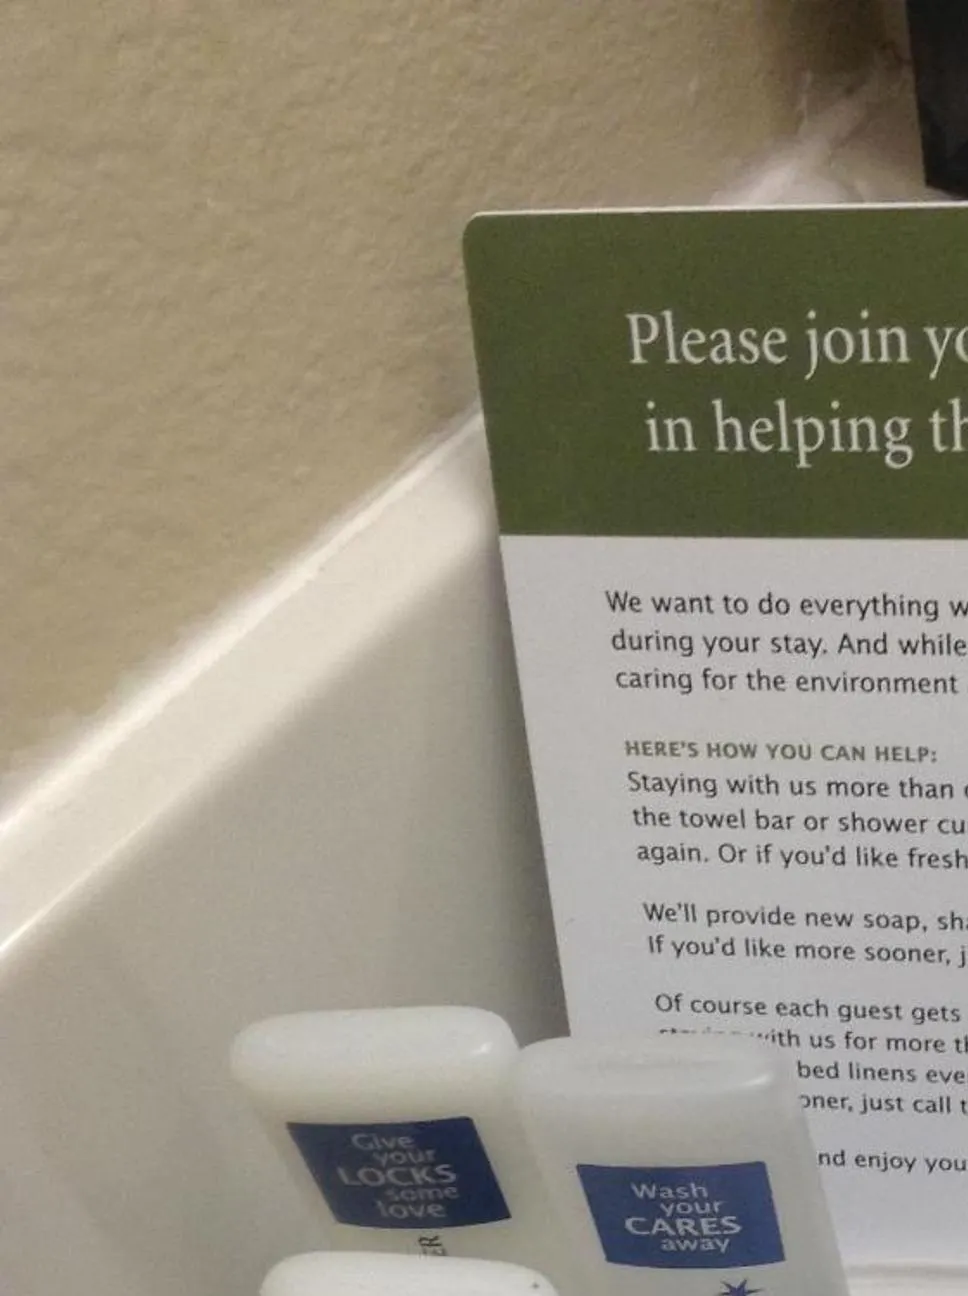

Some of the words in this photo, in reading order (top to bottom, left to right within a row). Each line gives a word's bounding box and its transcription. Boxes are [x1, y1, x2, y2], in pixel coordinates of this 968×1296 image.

[626, 309, 788, 365] Please
[804, 309, 912, 381] join
[645, 400, 698, 453] in
[711, 398, 915, 470] helping
[604, 589, 643, 614] We
[650, 593, 715, 615] want
[721, 594, 750, 616] to
[757, 591, 791, 616] do
[799, 591, 940, 624] everything
[610, 627, 694, 658] during
[701, 635, 761, 659] your
[770, 633, 829, 660] stay.
[836, 631, 889, 656] And
[897, 631, 968, 658] while
[615, 667, 693, 696] caring
[701, 666, 738, 691] for
[745, 667, 787, 693] the
[795, 670, 960, 695] environment
[624, 740, 700, 759] HERE'S
[705, 741, 758, 760] HOW
[765, 743, 812, 761] YOU
[819, 744, 866, 762] CAN
[874, 745, 938, 764] HELP:
[627, 770, 718, 799] Staying
[725, 773, 780, 797] with
[788, 779, 817, 797] us
[825, 780, 891, 798] more
[898, 776, 955, 800] than
[631, 805, 672, 828] the
[678, 807, 747, 830] towel
[754, 807, 796, 831] bar
[802, 815, 830, 832] or
[837, 810, 930, 835] shower
[636, 842, 710, 867] again.
[717, 842, 748, 864] Or
[755, 842, 773, 865] if
[779, 844, 847, 870] you'd
[855, 845, 899, 869] like
[641, 901, 698, 923] We'll
[705, 904, 797, 929] provide
[804, 911, 855, 928] new
[863, 913, 928, 935] soap,
[647, 933, 665, 955] If
[670, 935, 737, 960] you'd
[744, 936, 787, 959] like
[794, 943, 856, 961] more
[863, 945, 951, 967] sooner,
[654, 992, 684, 1013] Of
[689, 999, 769, 1016] course
[774, 997, 829, 1018] each
[837, 1003, 903, 1024] guest
[911, 1005, 962, 1026] gets
[796, 1059, 840, 1080] bed
[848, 1061, 917, 1083] linens
[350, 1132, 415, 1151] Give
[372, 1149, 437, 1168] your
[854, 1151, 918, 1174] enjoy
[335, 1164, 457, 1187] LOCKS
[630, 1182, 709, 1200] Wash
[375, 1199, 448, 1220] love
[659, 1200, 726, 1218] your
[624, 1215, 743, 1237] CARES
[660, 1237, 731, 1254] away
